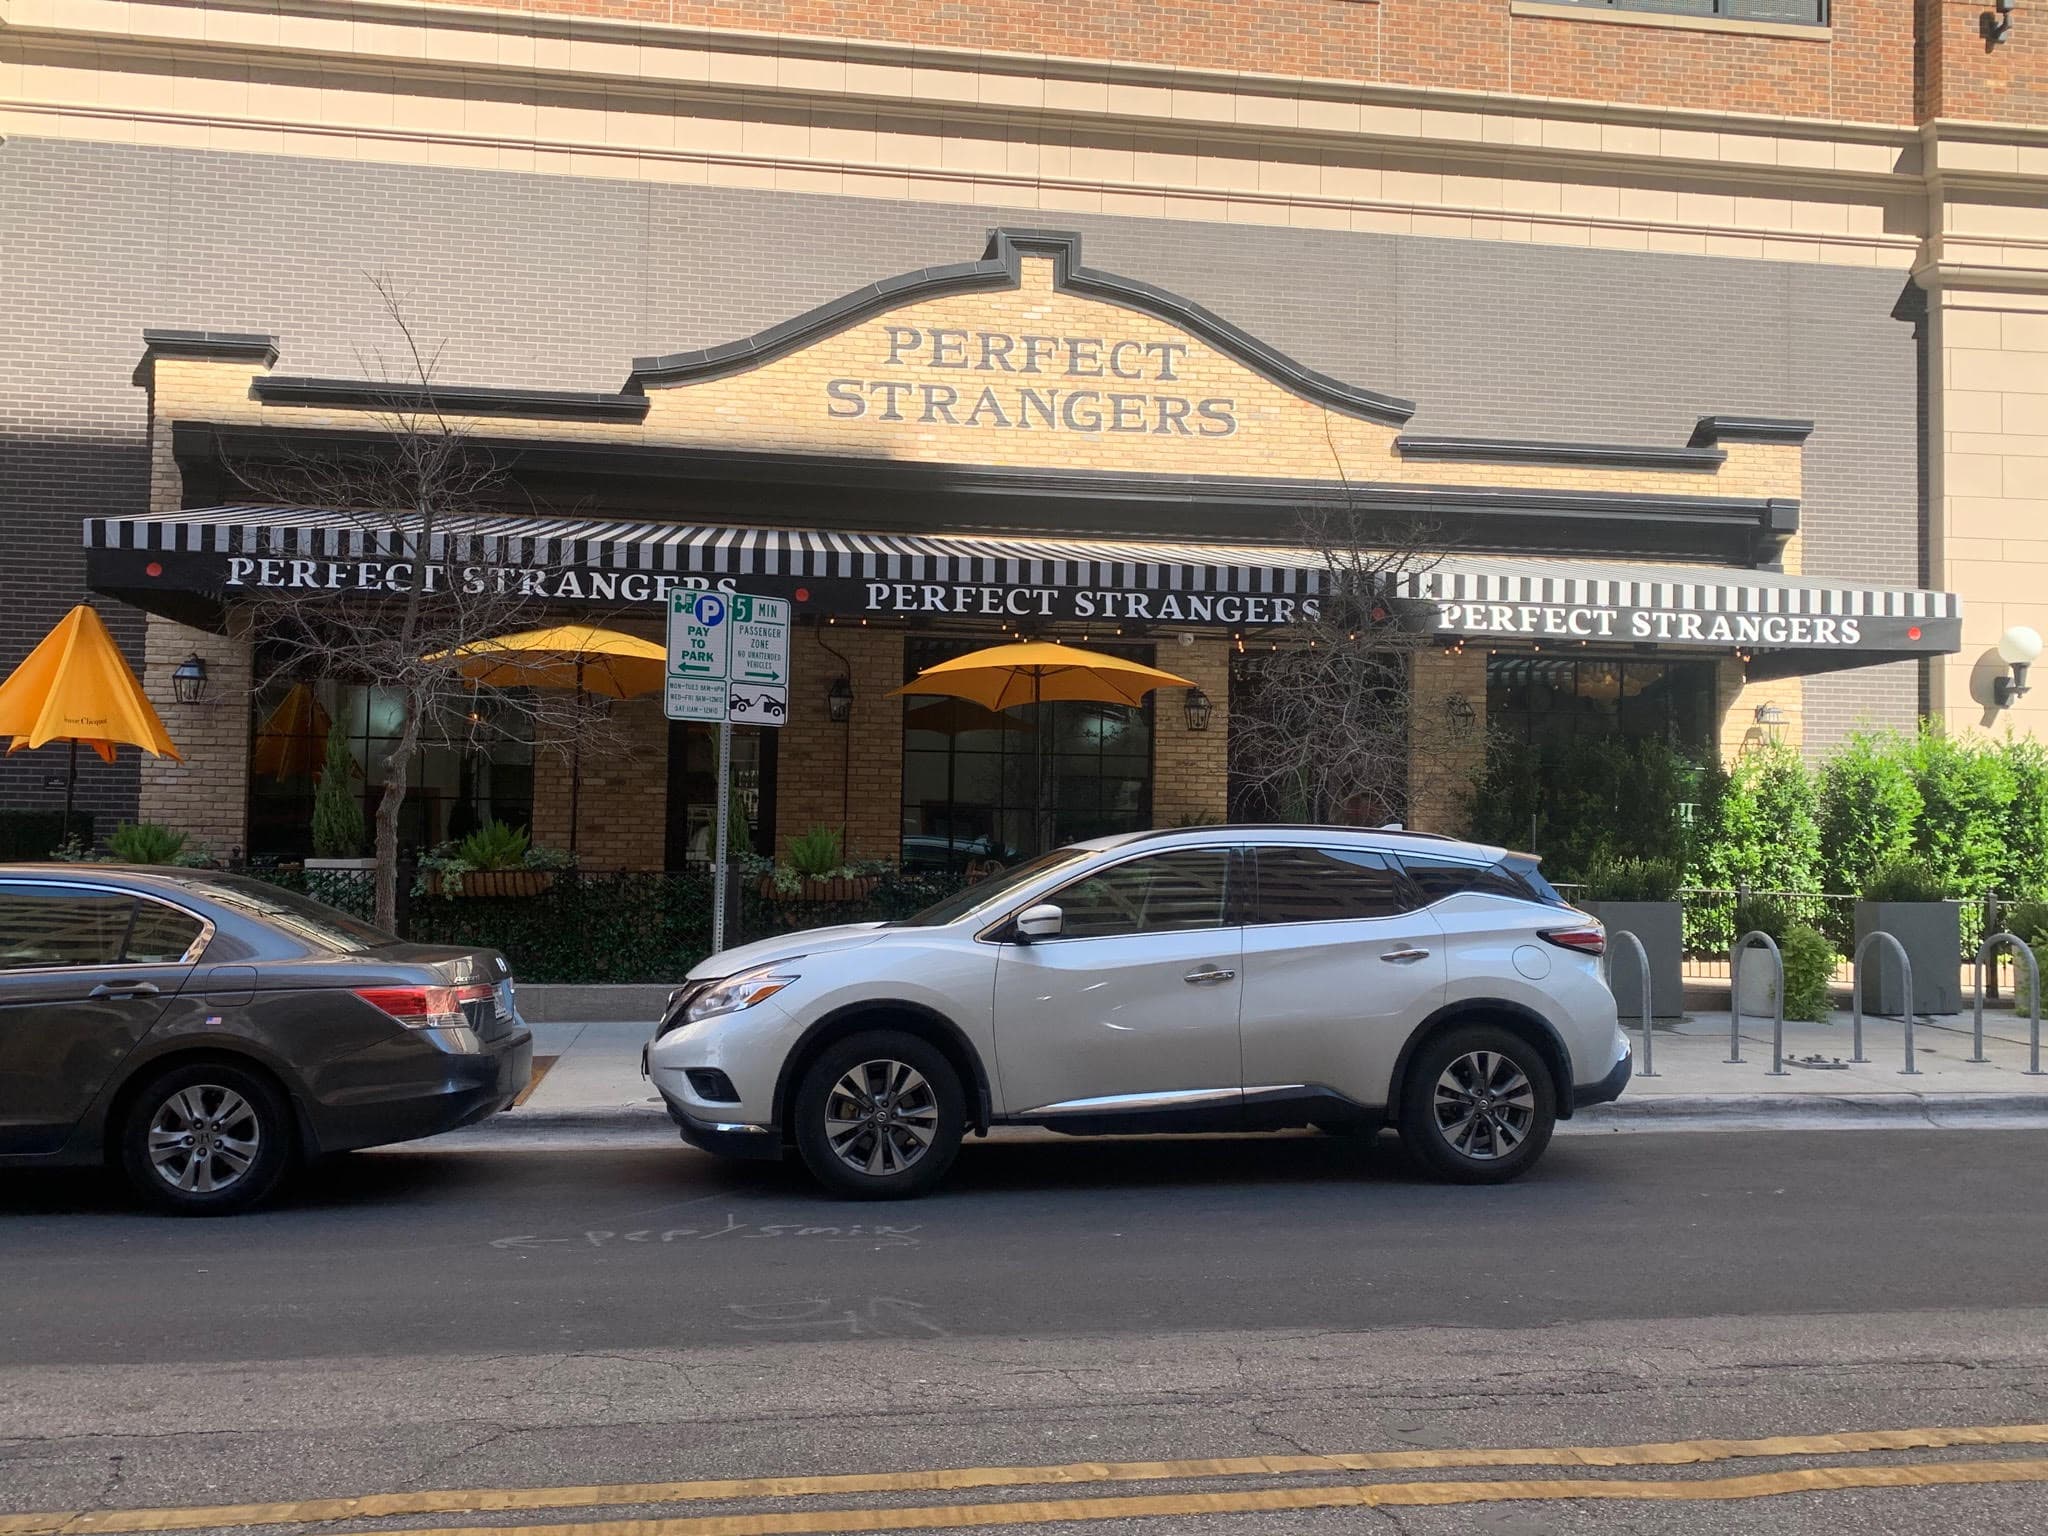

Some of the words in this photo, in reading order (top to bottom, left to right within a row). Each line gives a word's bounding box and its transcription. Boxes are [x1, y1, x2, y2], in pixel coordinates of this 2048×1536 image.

[883, 326, 1189, 381] PERFECT
[827, 379, 1238, 437] STRANGERS
[225, 557, 444, 593] PERFECT
[736, 598, 747, 620] 5
[758, 603, 778, 618] MIN
[865, 583, 1059, 616] PERFECT
[1074, 591, 1321, 623] STRANGERS
[688, 625, 710, 637] PAY
[739, 624, 782, 638] PASSENGER
[1437, 603, 1618, 636] PERFECT
[1632, 611, 1861, 645] STRANGERS
[690, 638, 706, 649] TO
[750, 638, 769, 650] ZONE
[681, 650, 714, 662] PARK
[737, 650, 746, 658] NO
[748, 651, 782, 661] UNATTENDED
[747, 660, 772, 670] VEHICLES
